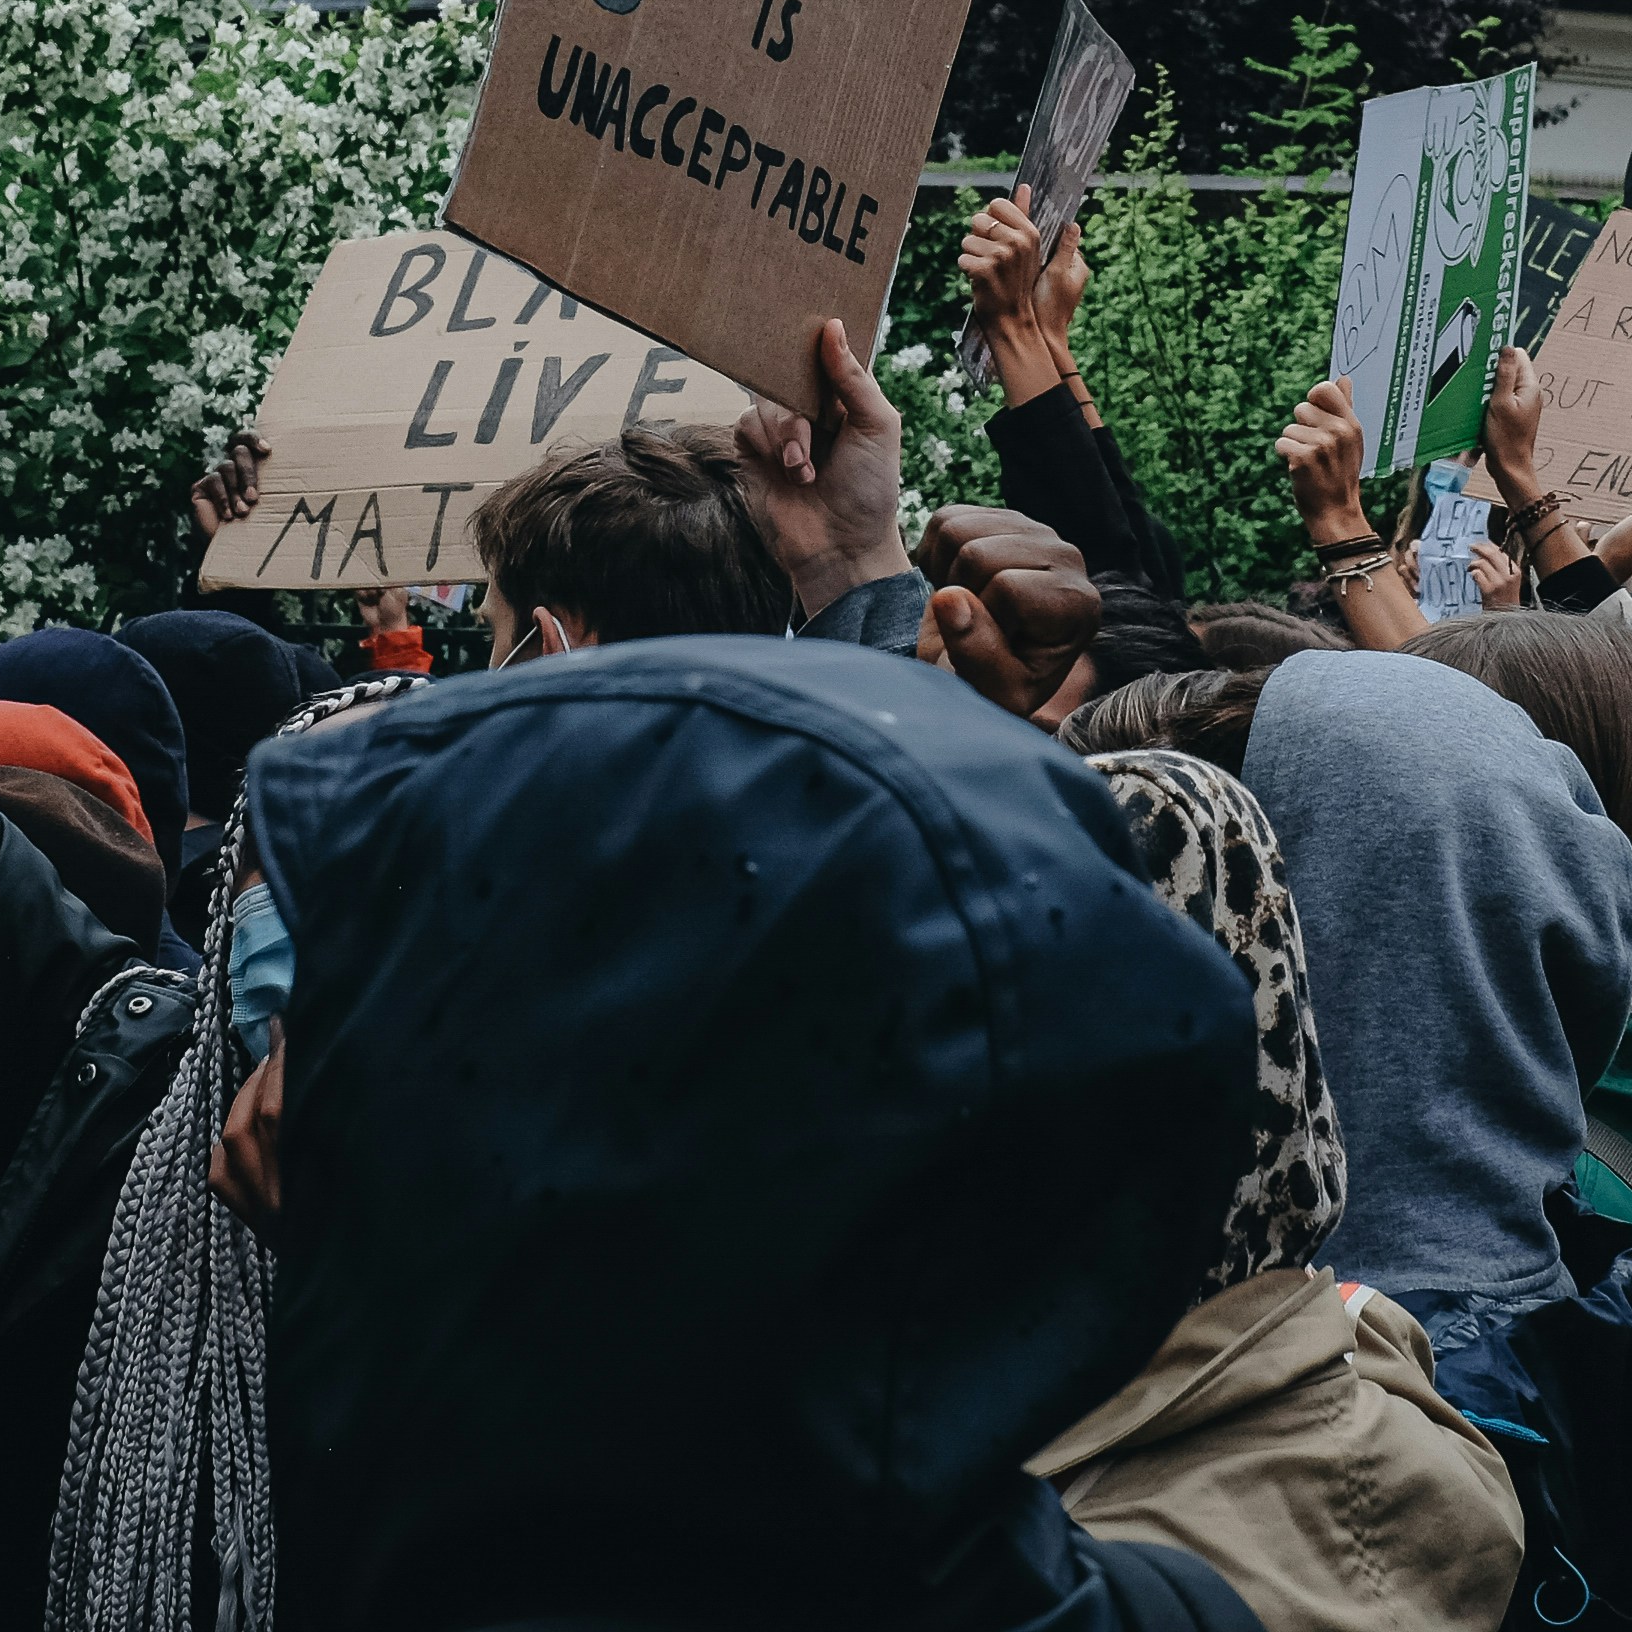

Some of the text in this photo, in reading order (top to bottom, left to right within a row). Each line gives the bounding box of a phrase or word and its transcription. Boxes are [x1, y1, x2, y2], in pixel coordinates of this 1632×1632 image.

[536, 34, 880, 265] UNACCEPTABLE
[1341, 212, 1401, 367] BLM
[1563, 297, 1596, 332] A
[1538, 372, 1615, 411] BUT
[256, 482, 475, 581] MAT
